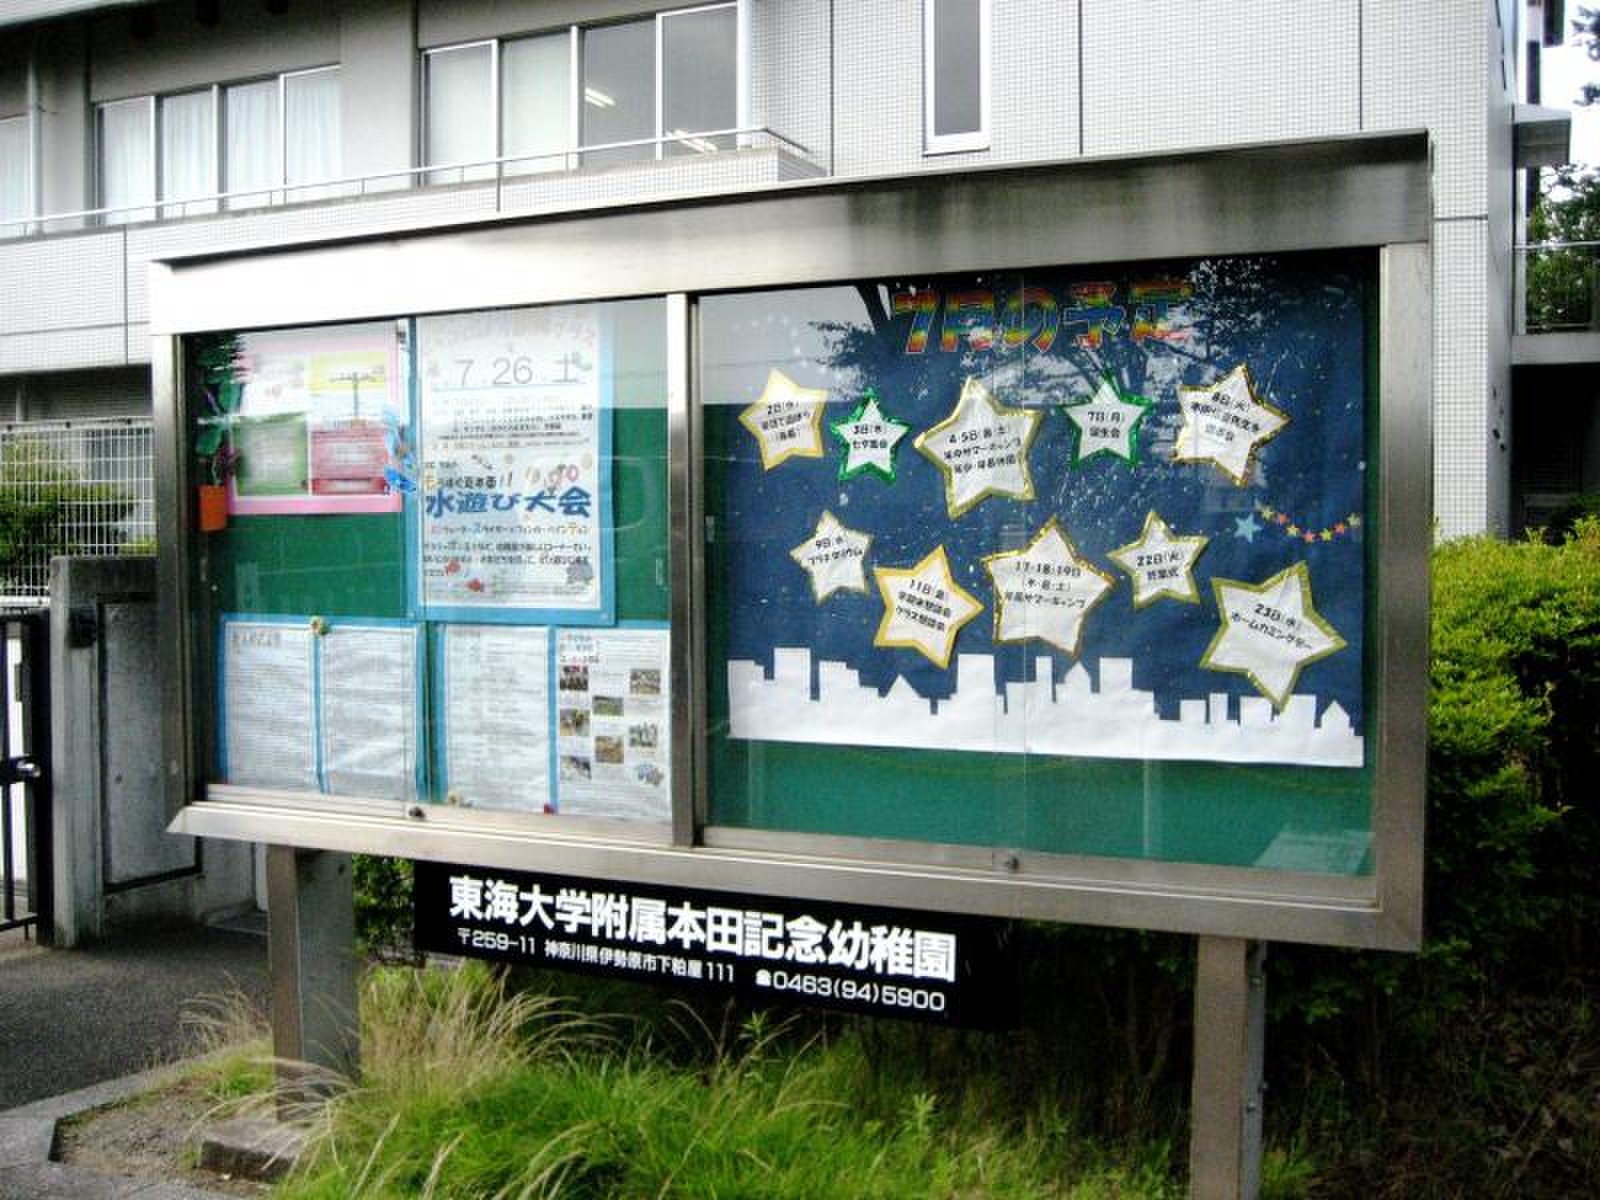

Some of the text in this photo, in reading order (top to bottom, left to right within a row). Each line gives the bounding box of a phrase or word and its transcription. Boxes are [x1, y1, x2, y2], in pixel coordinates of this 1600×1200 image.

[895, 279, 1192, 353] 7月の予定
[454, 359, 474, 386] 7
[492, 356, 533, 385] 26
[425, 486, 592, 518] 水遊び大会
[448, 876, 957, 983] 東海大学附属本田記念幼稚園
